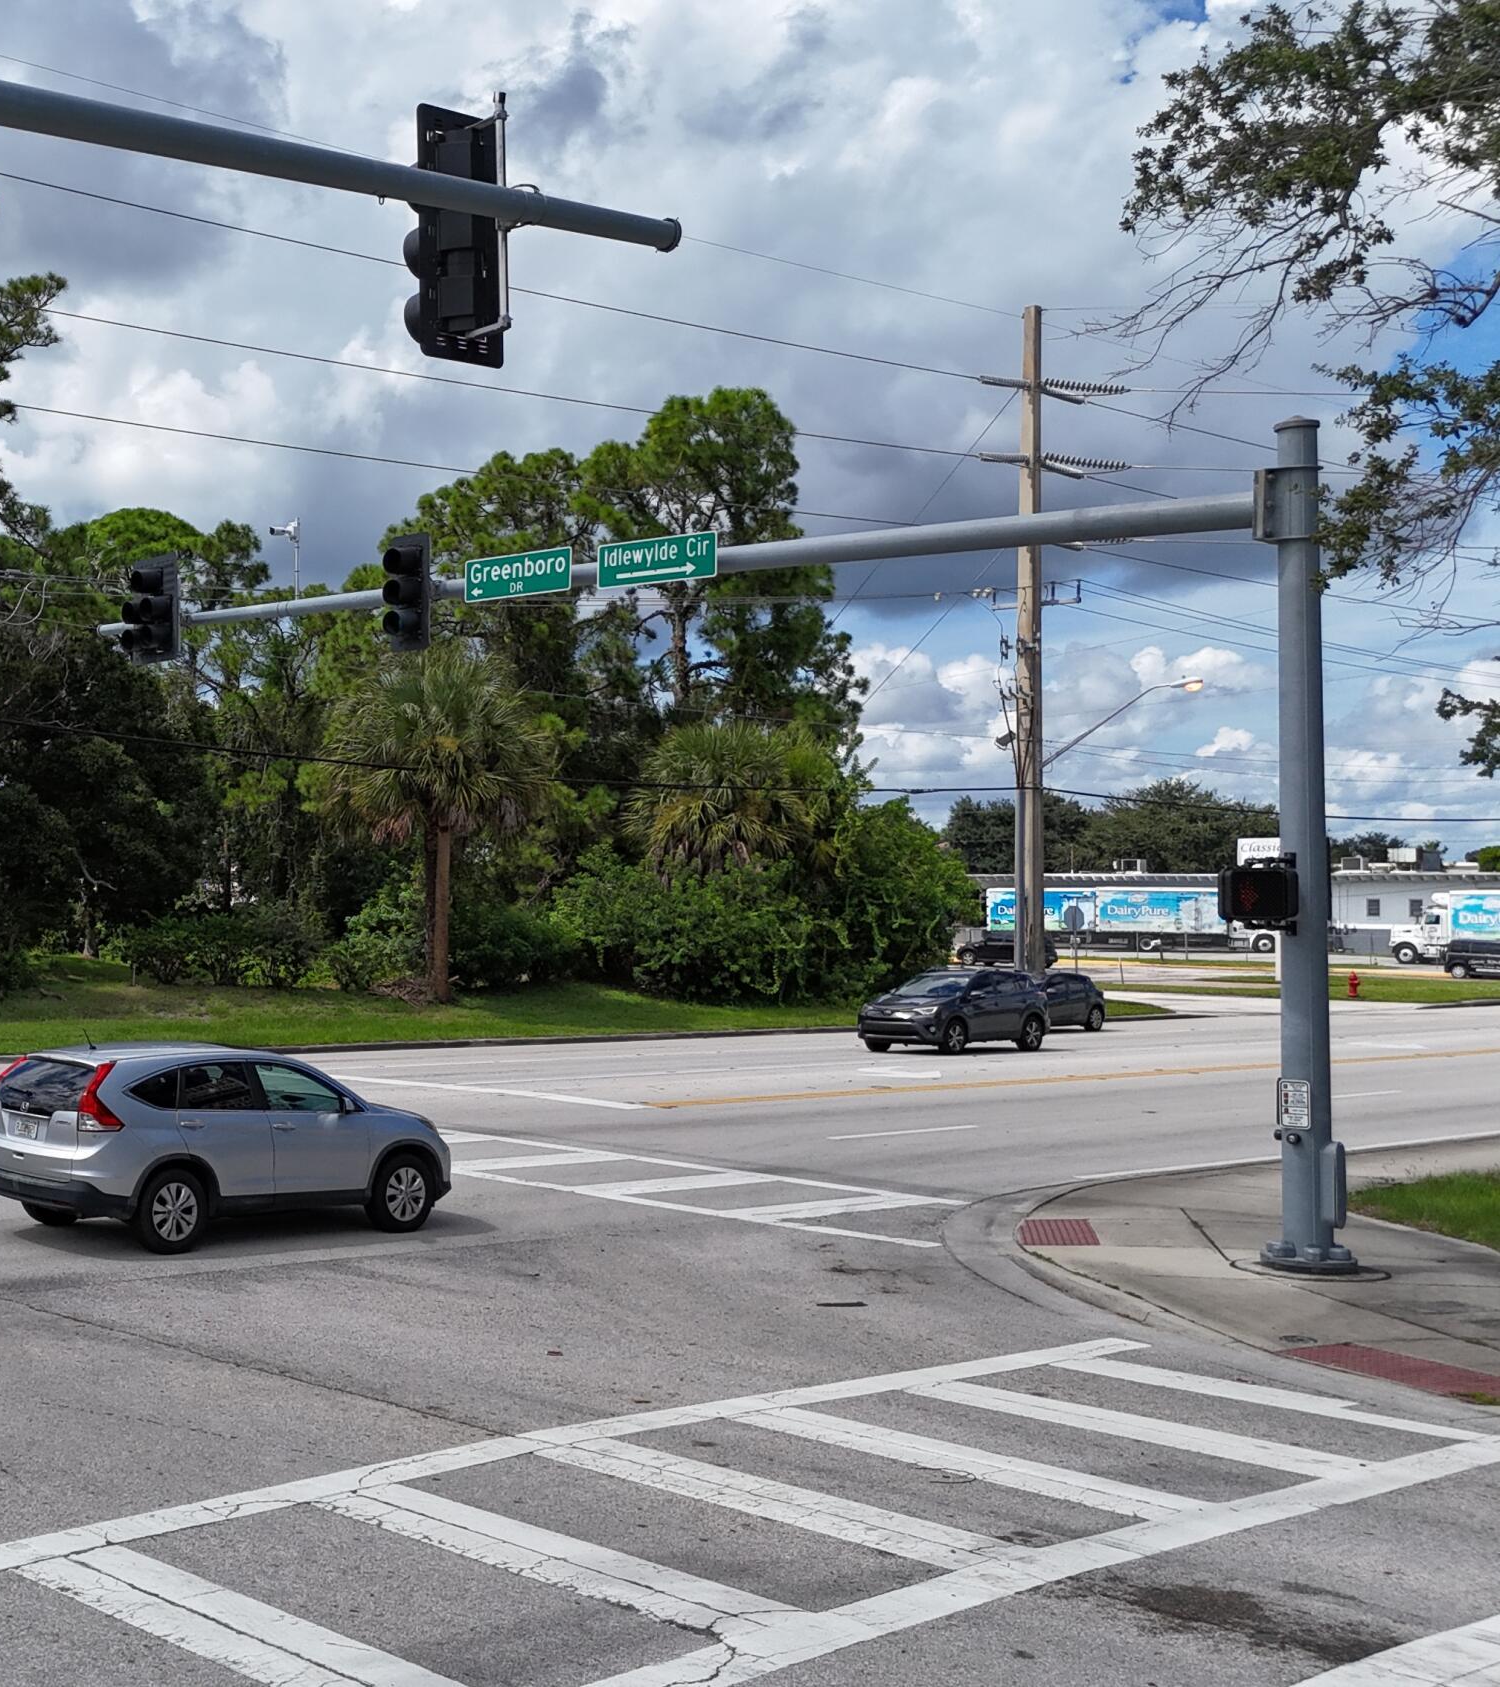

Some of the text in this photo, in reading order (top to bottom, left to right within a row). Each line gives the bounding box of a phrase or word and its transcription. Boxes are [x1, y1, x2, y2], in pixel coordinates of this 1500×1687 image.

[604, 537, 710, 568] Idlewylde Cir
[470, 555, 566, 585] Greenboro
[509, 581, 524, 593] DR
[1106, 905, 1169, 918] DairyPure
